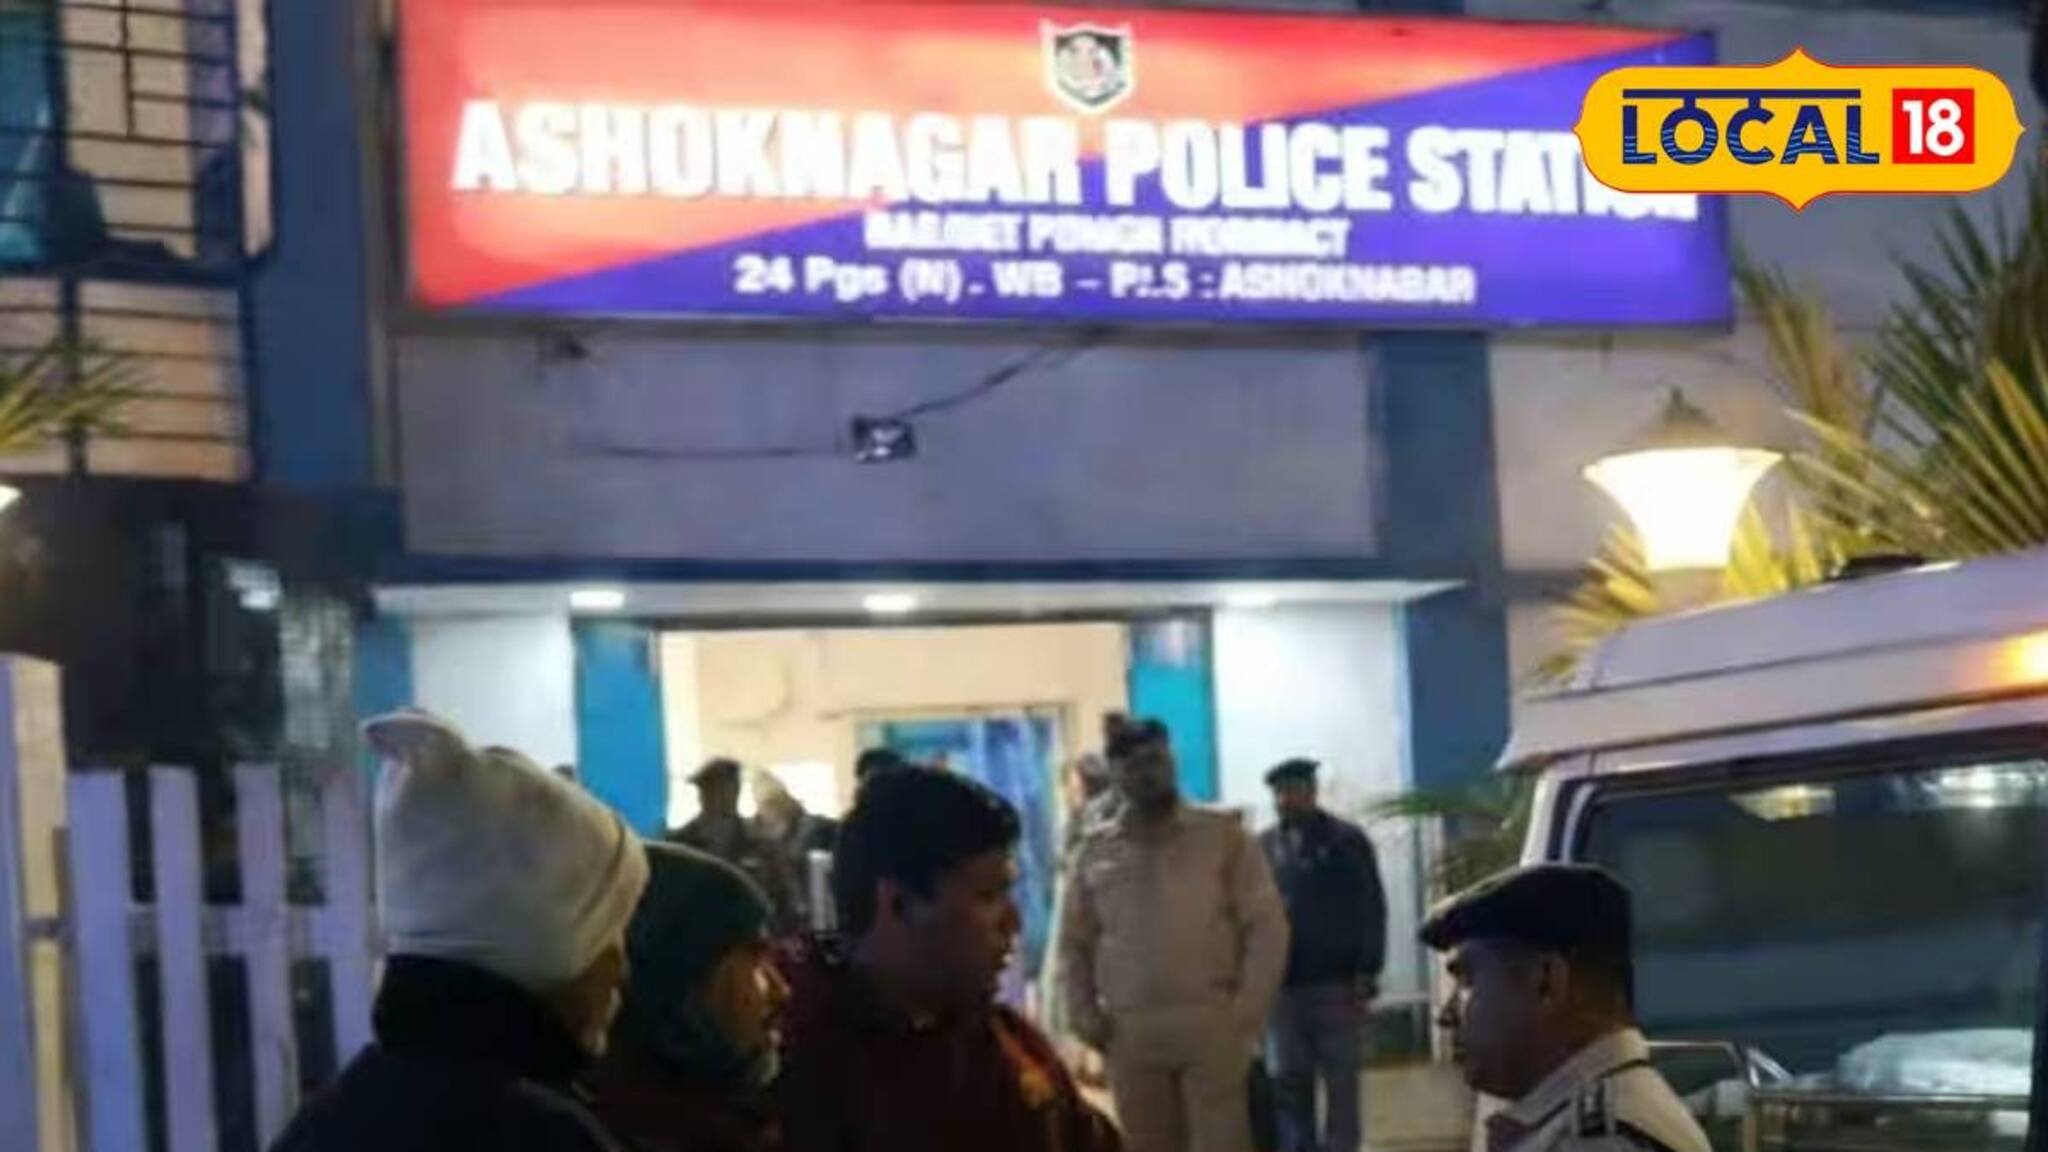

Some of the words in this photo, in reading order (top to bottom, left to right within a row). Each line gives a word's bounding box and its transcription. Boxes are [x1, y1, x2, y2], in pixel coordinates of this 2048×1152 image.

[452, 100, 1083, 204] ASHOKNAGAR
[1104, 118, 1393, 212] POLICE
[734, 254, 795, 294] 24
[804, 255, 890, 301] Pgs
[991, 260, 1064, 297] WB
